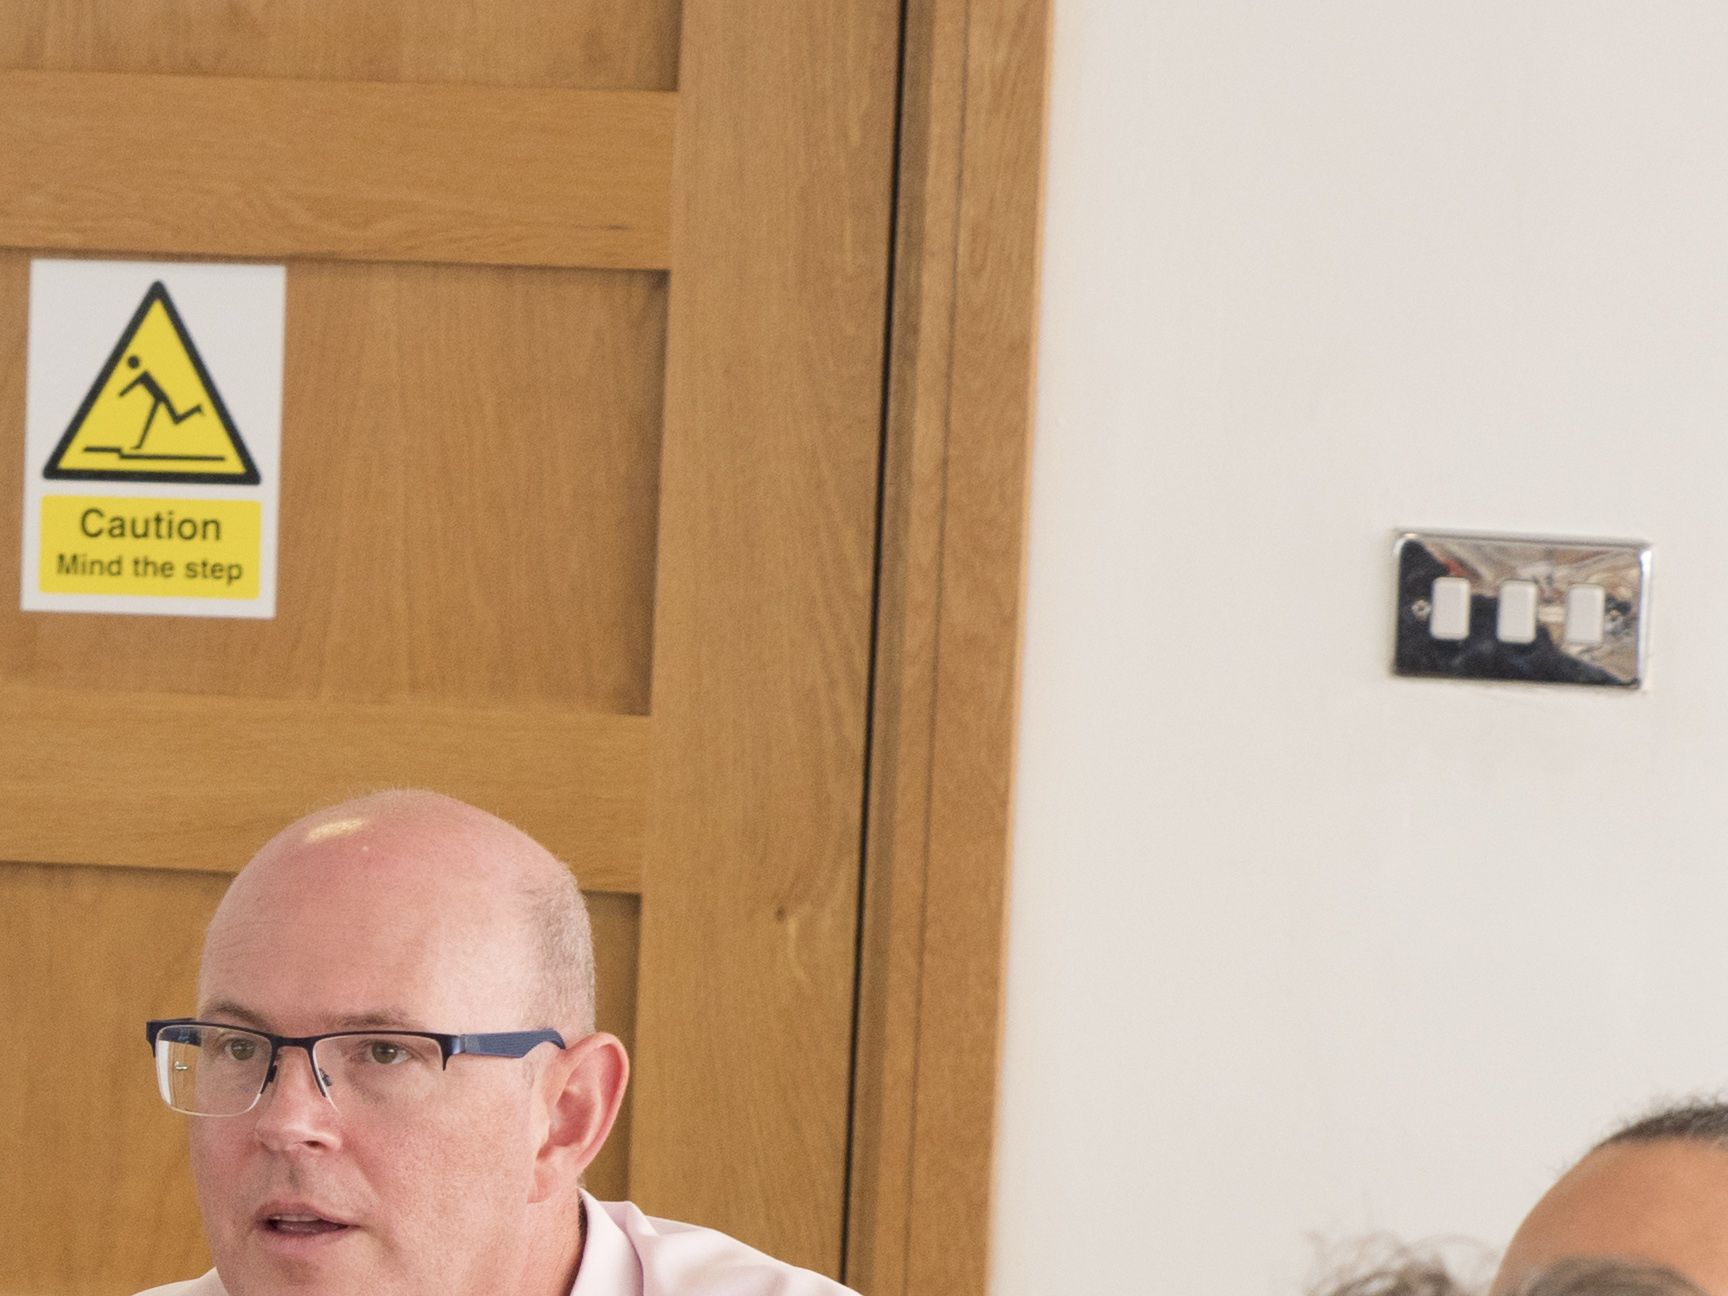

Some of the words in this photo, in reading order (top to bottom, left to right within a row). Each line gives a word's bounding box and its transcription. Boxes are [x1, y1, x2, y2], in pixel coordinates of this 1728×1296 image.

[79, 507, 222, 541] Caution
[56, 553, 124, 578] Mind
[132, 555, 176, 579] the
[184, 558, 244, 586] step
